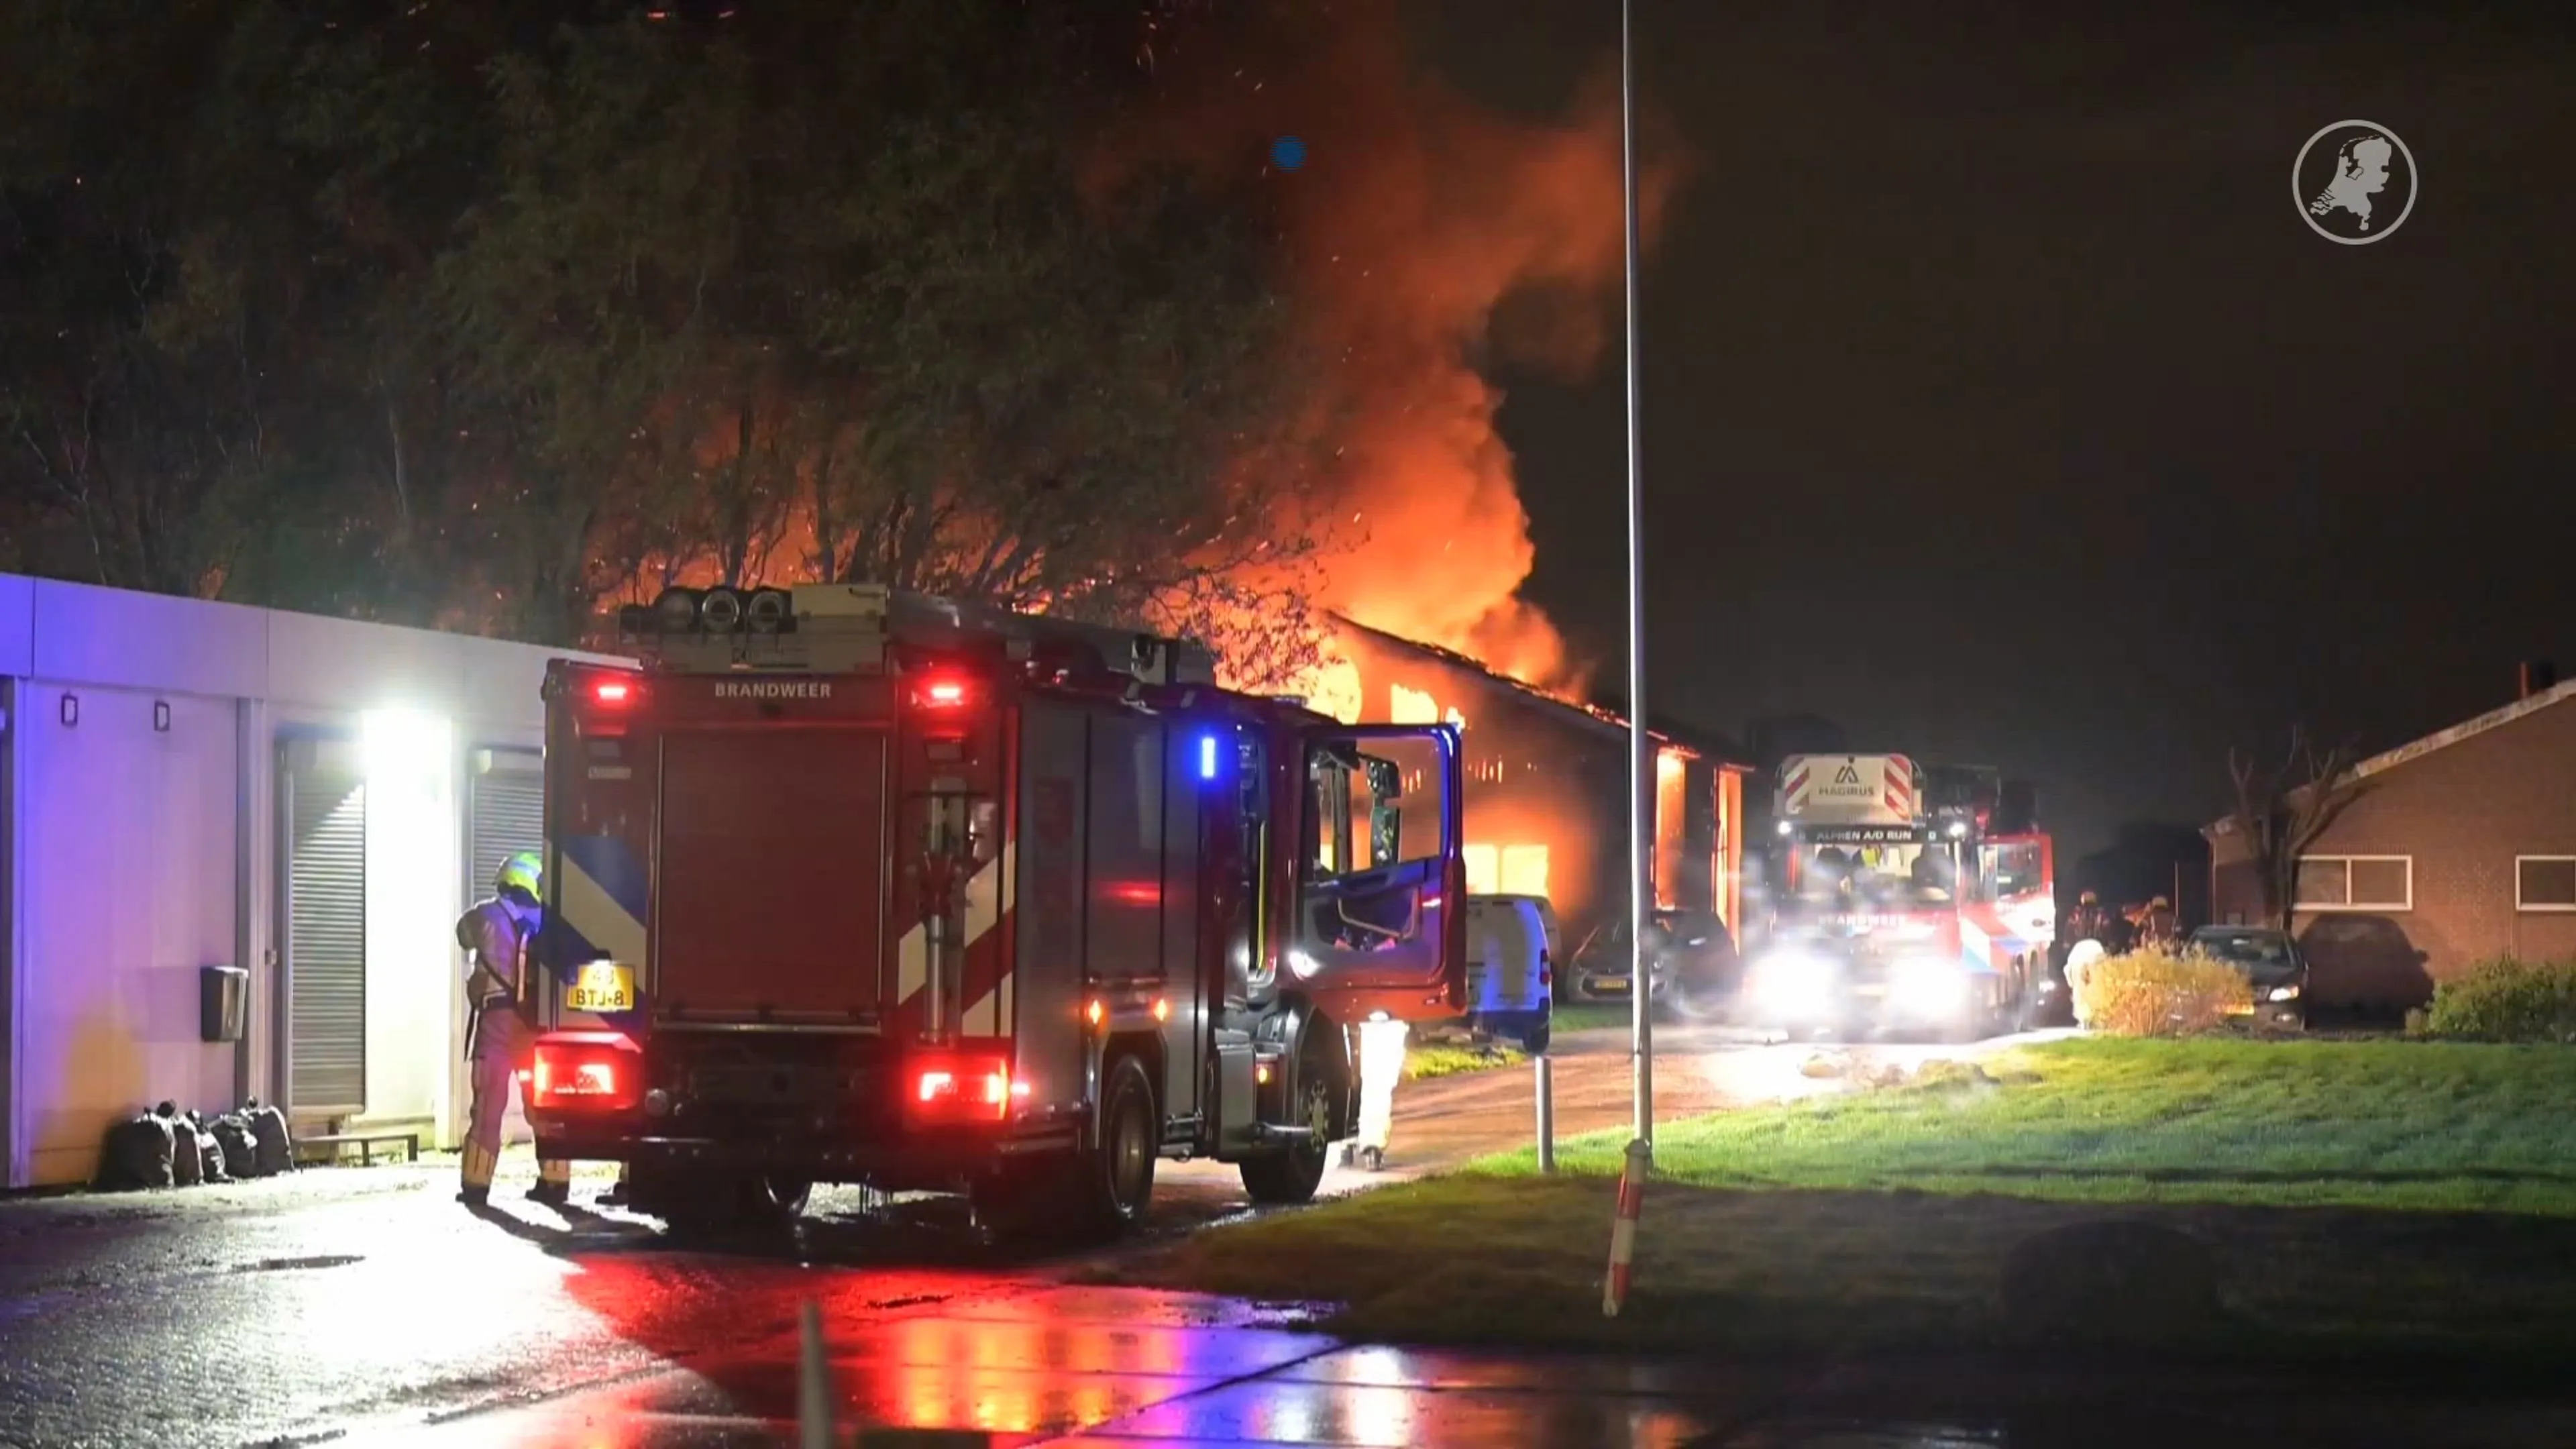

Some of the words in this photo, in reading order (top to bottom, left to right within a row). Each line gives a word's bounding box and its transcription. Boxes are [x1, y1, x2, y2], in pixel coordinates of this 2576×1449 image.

[715, 683, 831, 698] BRANDWEER
[1819, 786, 1874, 796] MAGIRUS
[1817, 830, 1860, 841] ALPHEN
[1863, 830, 1884, 841] A/D
[576, 989, 625, 1006] BTJ-8
